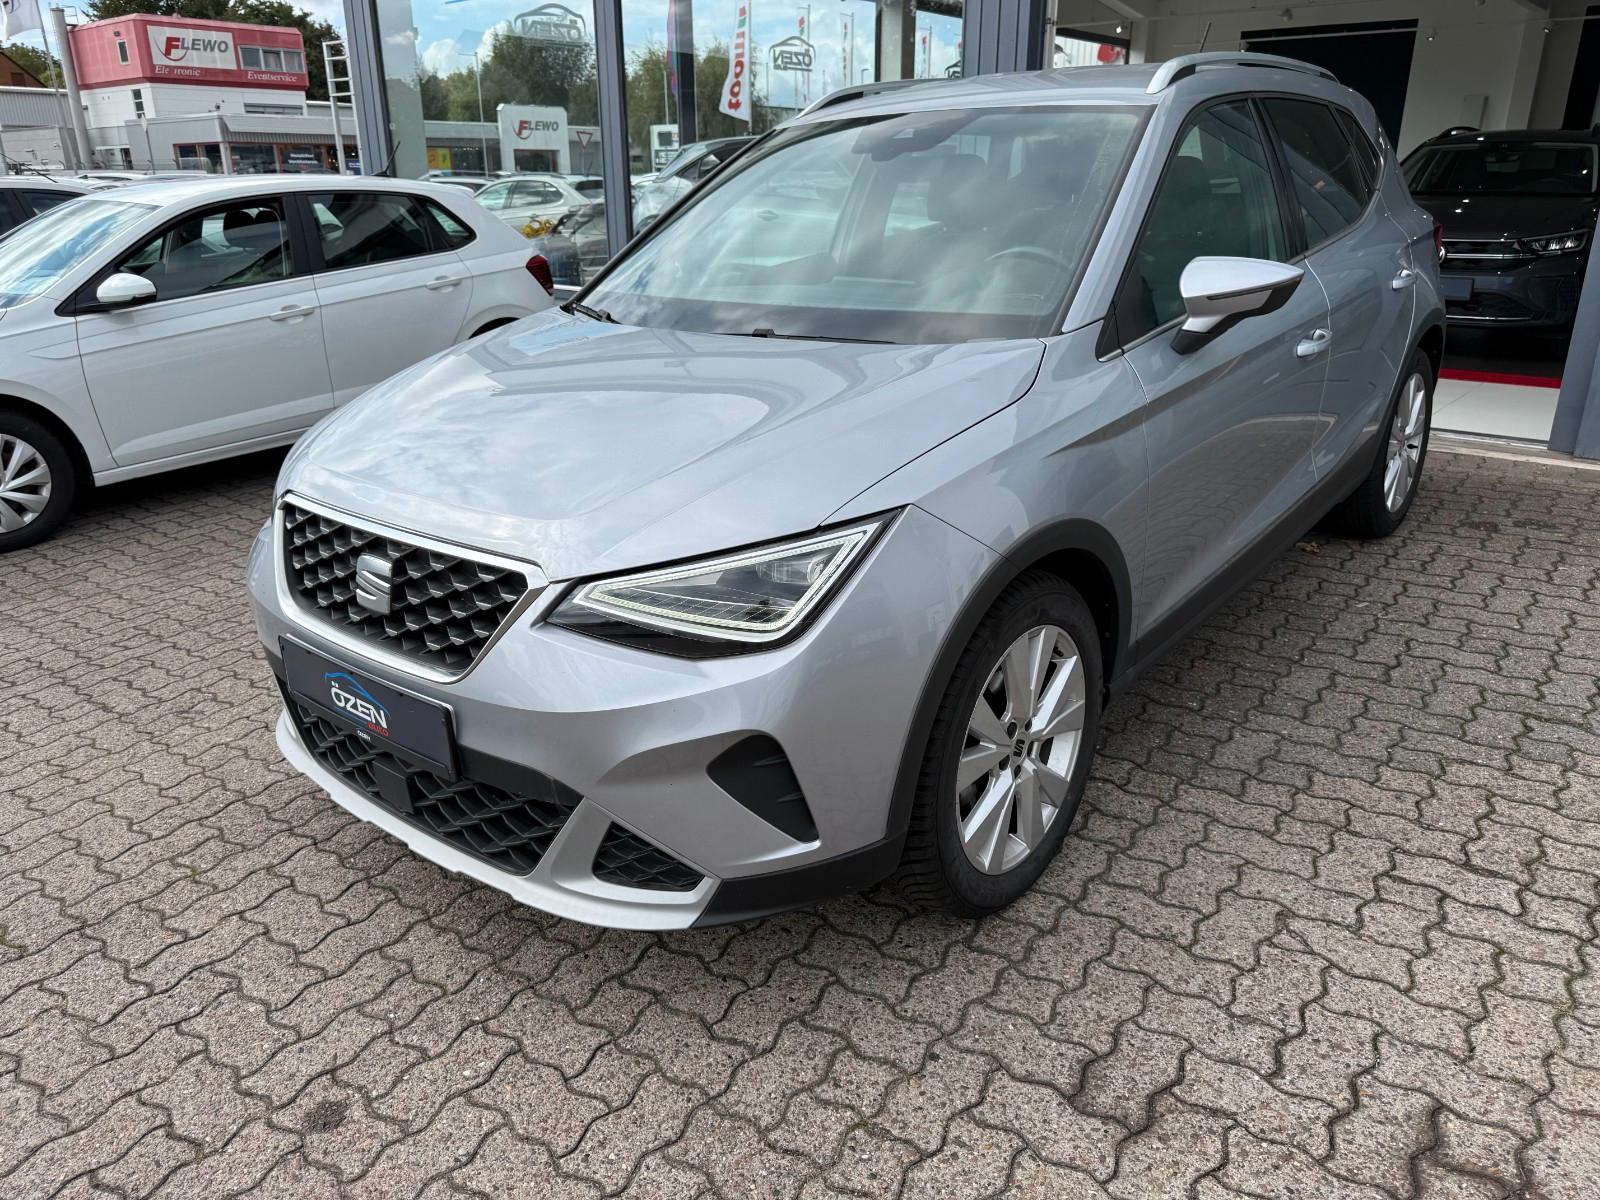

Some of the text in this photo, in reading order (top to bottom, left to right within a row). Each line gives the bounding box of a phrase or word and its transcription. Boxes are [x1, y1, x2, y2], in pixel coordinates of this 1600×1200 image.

[164, 36, 229, 57] FLEWO
[247, 71, 297, 82] Eventservice
[517, 120, 559, 137] FLEWO
[331, 681, 387, 728] ÖZEN
